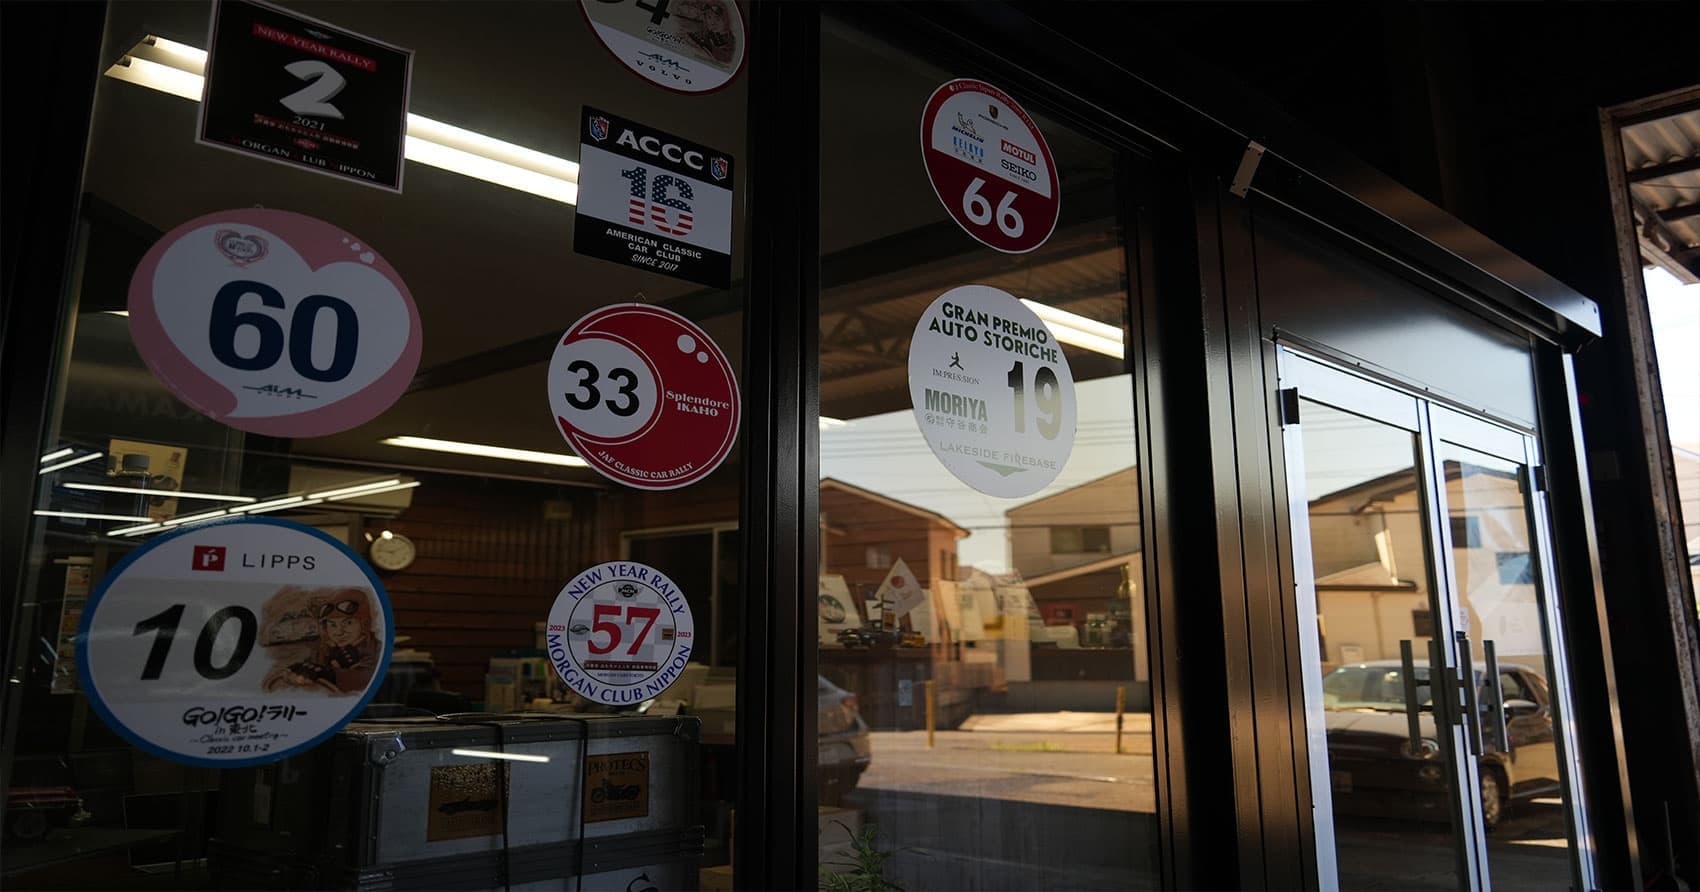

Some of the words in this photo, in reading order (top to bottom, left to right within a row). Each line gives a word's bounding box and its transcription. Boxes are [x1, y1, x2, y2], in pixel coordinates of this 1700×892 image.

[257, 25, 289, 42] NEW
[294, 37, 330, 56] YEAR
[329, 49, 372, 69] RALLY
[636, 59, 692, 84] VOLVO
[280, 59, 345, 121] 2
[292, 115, 326, 132] 2021
[615, 128, 705, 171] ACCC
[1003, 143, 1036, 163] MOTUL
[1000, 158, 1037, 181] SEIKO
[621, 166, 694, 236] 16
[962, 176, 1025, 239] 66
[605, 228, 658, 248] AMERICAN
[662, 243, 702, 260] CLASSIC
[628, 242, 648, 254] CAR
[656, 250, 681, 262] CLUB
[631, 254, 658, 267] SINCE
[658, 260, 679, 272] 2017
[208, 280, 360, 383] 60
[942, 301, 989, 327] GRAN
[993, 316, 1047, 345] PREMIO
[929, 316, 978, 342] AUTO
[983, 330, 1058, 364] STORICHE
[564, 359, 640, 417] 33
[665, 389, 730, 410] Splendore
[1007, 360, 1062, 441] 19
[676, 402, 719, 417] IKAHO
[925, 388, 988, 422] MORIYA
[598, 450, 615, 465] JAF
[615, 460, 650, 479] CLASSIC
[650, 470, 669, 479] CAR
[669, 462, 694, 478] RALLY
[939, 441, 1001, 460] LAKESIDE
[1003, 452, 1057, 470] FIREBASE
[242, 553, 316, 571] LIPPS
[567, 568, 602, 601] NEW
[607, 564, 649, 581] YEAR
[650, 574, 685, 615] RALLY
[132, 604, 258, 681] 10
[548, 624, 566, 632] 2023
[587, 604, 661, 655] 57
[677, 630, 692, 638] 2023
[548, 634, 598, 697] MORGAN
[600, 687, 643, 703] CLUB
[646, 644, 691, 695] NIPPON
[207, 744, 235, 755] 2022
